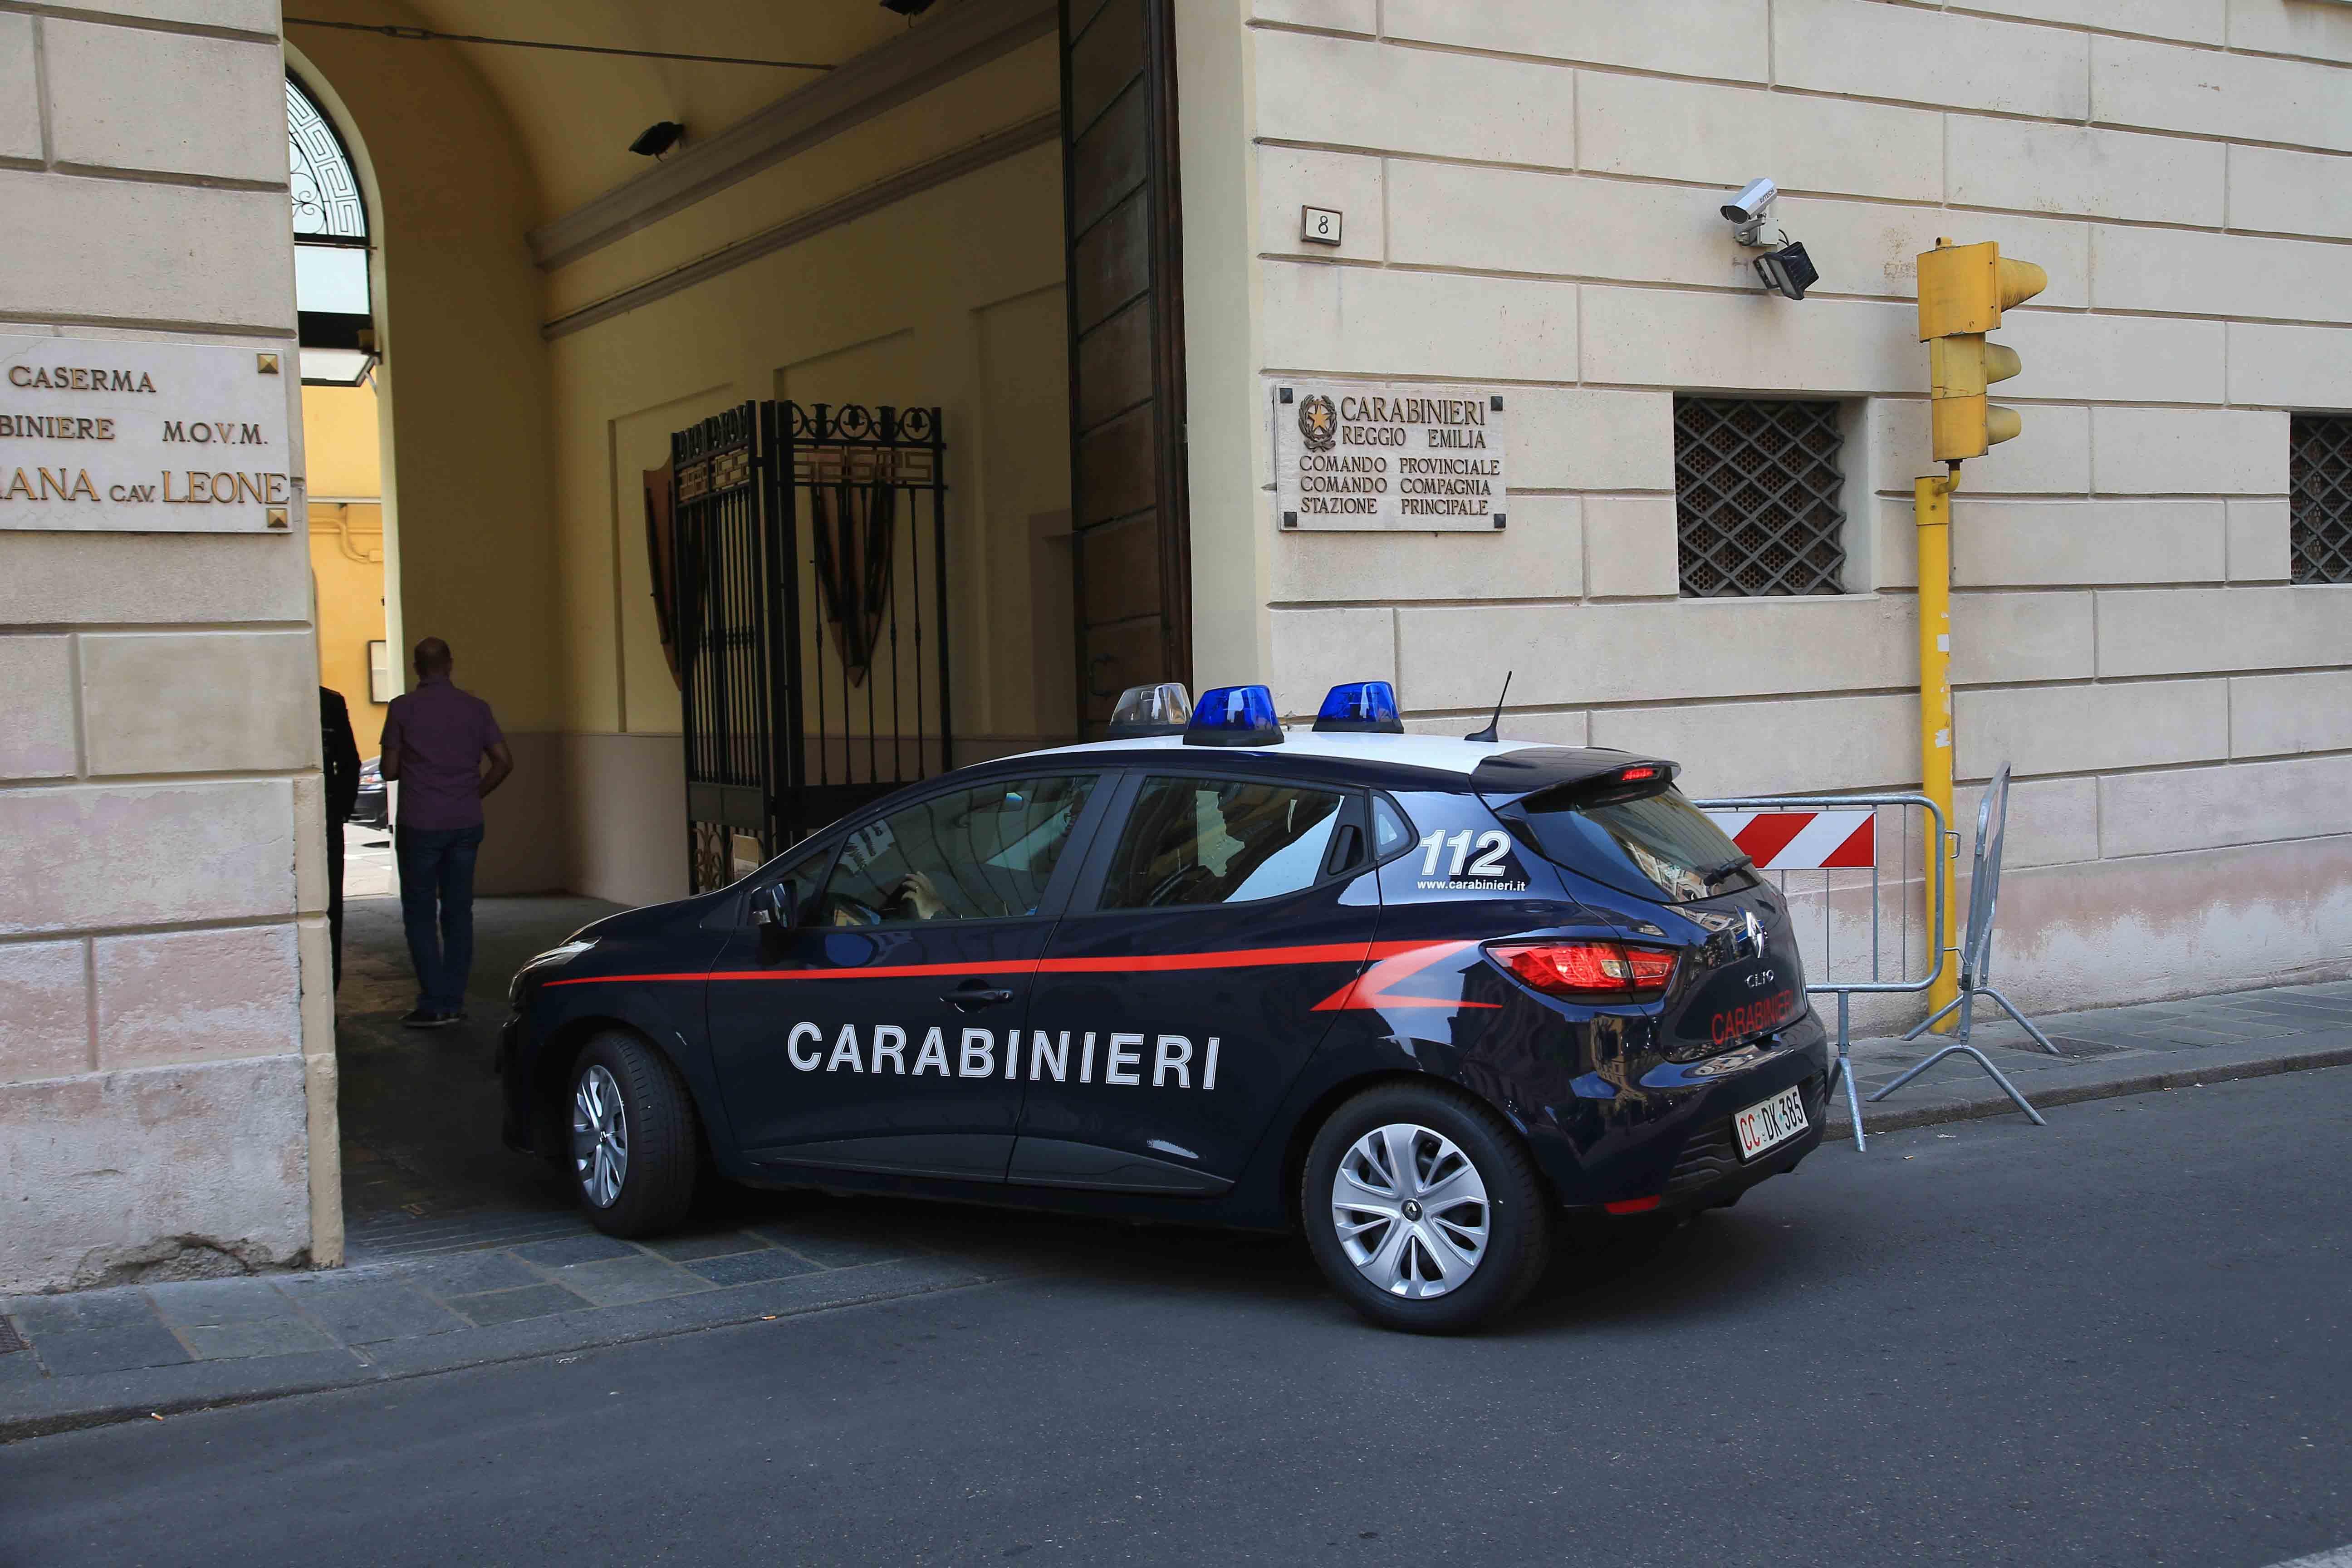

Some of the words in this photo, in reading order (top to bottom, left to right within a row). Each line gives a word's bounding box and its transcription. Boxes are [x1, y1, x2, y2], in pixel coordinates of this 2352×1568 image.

[1318, 215, 1328, 235] 8
[9, 365, 157, 393] CASERMA
[1341, 396, 1485, 426] CARABINIERI
[0, 415, 115, 440] BINIERE
[1342, 425, 1406, 446] REGGIO
[1428, 428, 1486, 449] EMILIA
[1299, 455, 1387, 473] COMANDO
[1400, 458, 1500, 475] PROVINCIALE
[0, 466, 101, 501] ANA
[109, 484, 154, 502] CAV.
[162, 470, 290, 504] LEONE
[1300, 475, 1387, 493] COMANDO
[1400, 478, 1492, 495] COMPAGNIA
[1301, 497, 1377, 514] STAZIONE
[1401, 499, 1489, 515] PRINCIPALE
[1420, 828, 1511, 877] 112
[1417, 879, 1526, 892] www.carabinieri.it
[1745, 969, 1775, 989] CLIO
[787, 1021, 1220, 1090] CARABINIERI
[1740, 1114, 1760, 1151] CC
[1761, 1103, 1783, 1141] DK
[1778, 1091, 1803, 1131] 385
